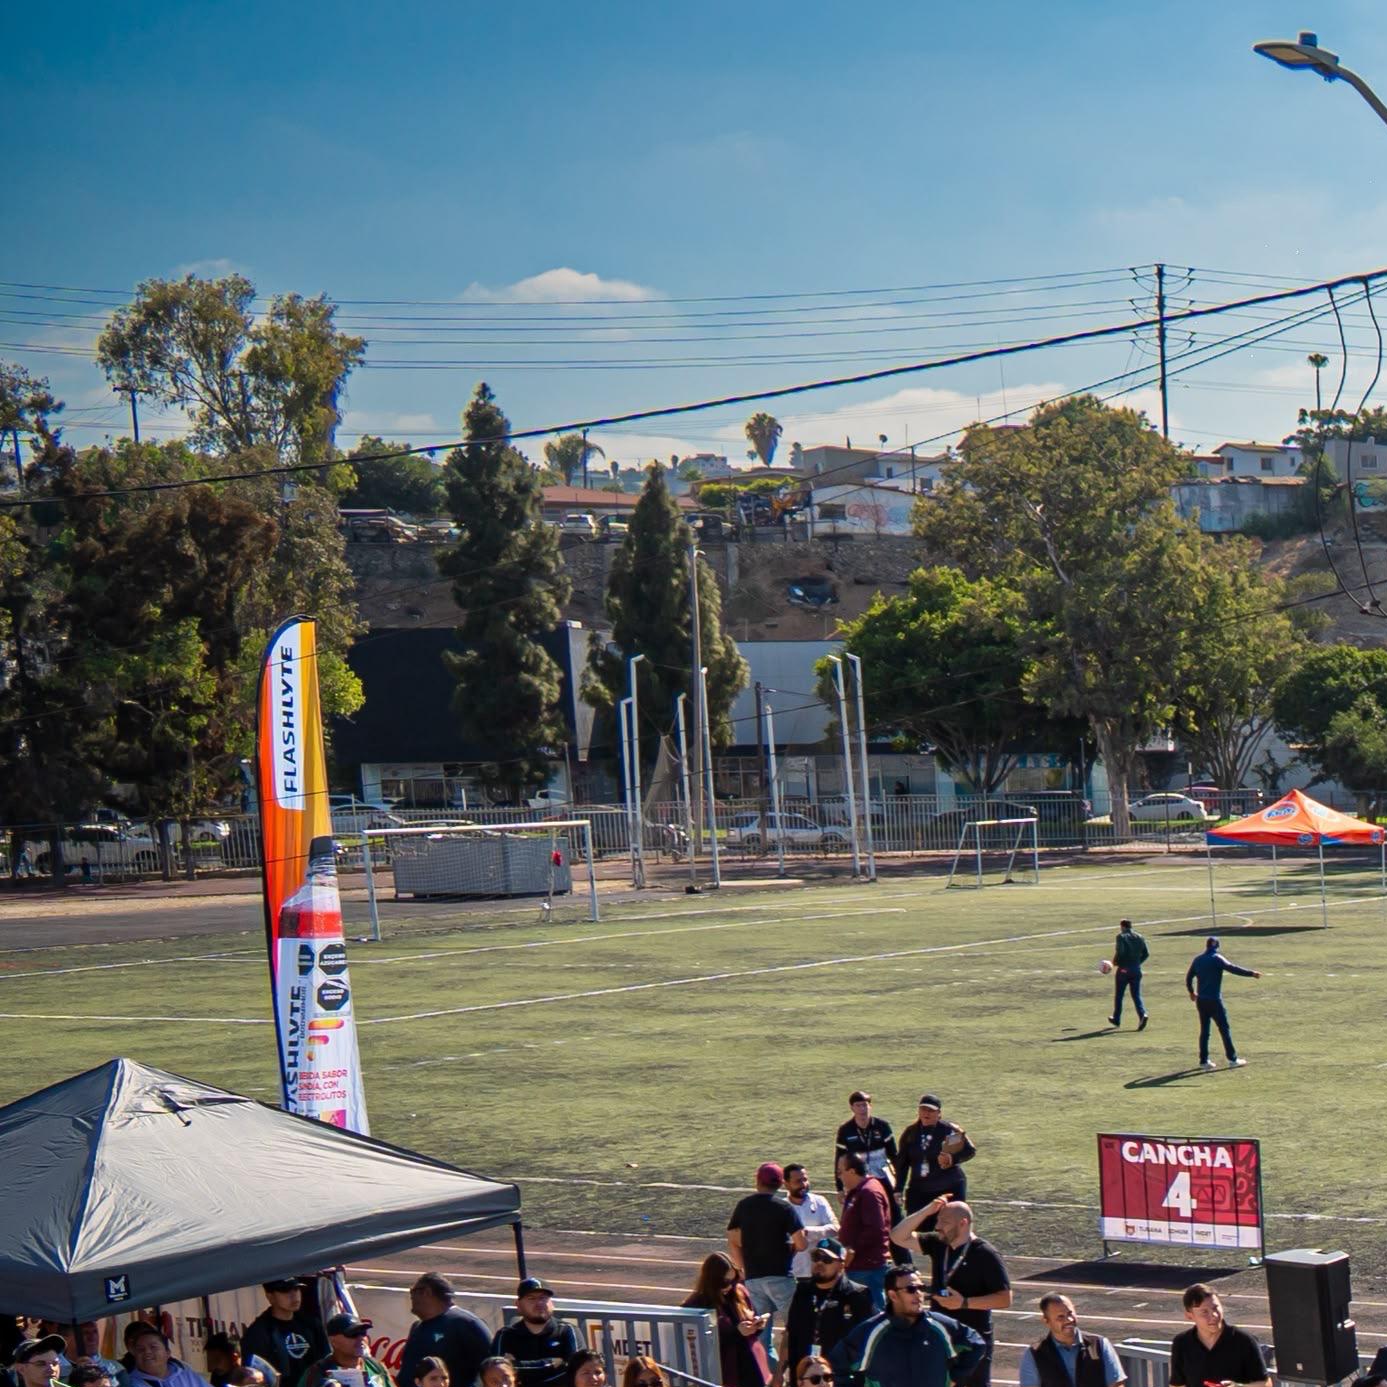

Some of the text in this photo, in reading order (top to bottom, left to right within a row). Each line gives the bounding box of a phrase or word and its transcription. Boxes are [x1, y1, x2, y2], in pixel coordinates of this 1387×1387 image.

[283, 645, 294, 793] FLASHLYTE
[1122, 1141, 1233, 1168] CANCHA
[1162, 1172, 1198, 1217] 4
[613, 1339, 651, 1357] MDET
